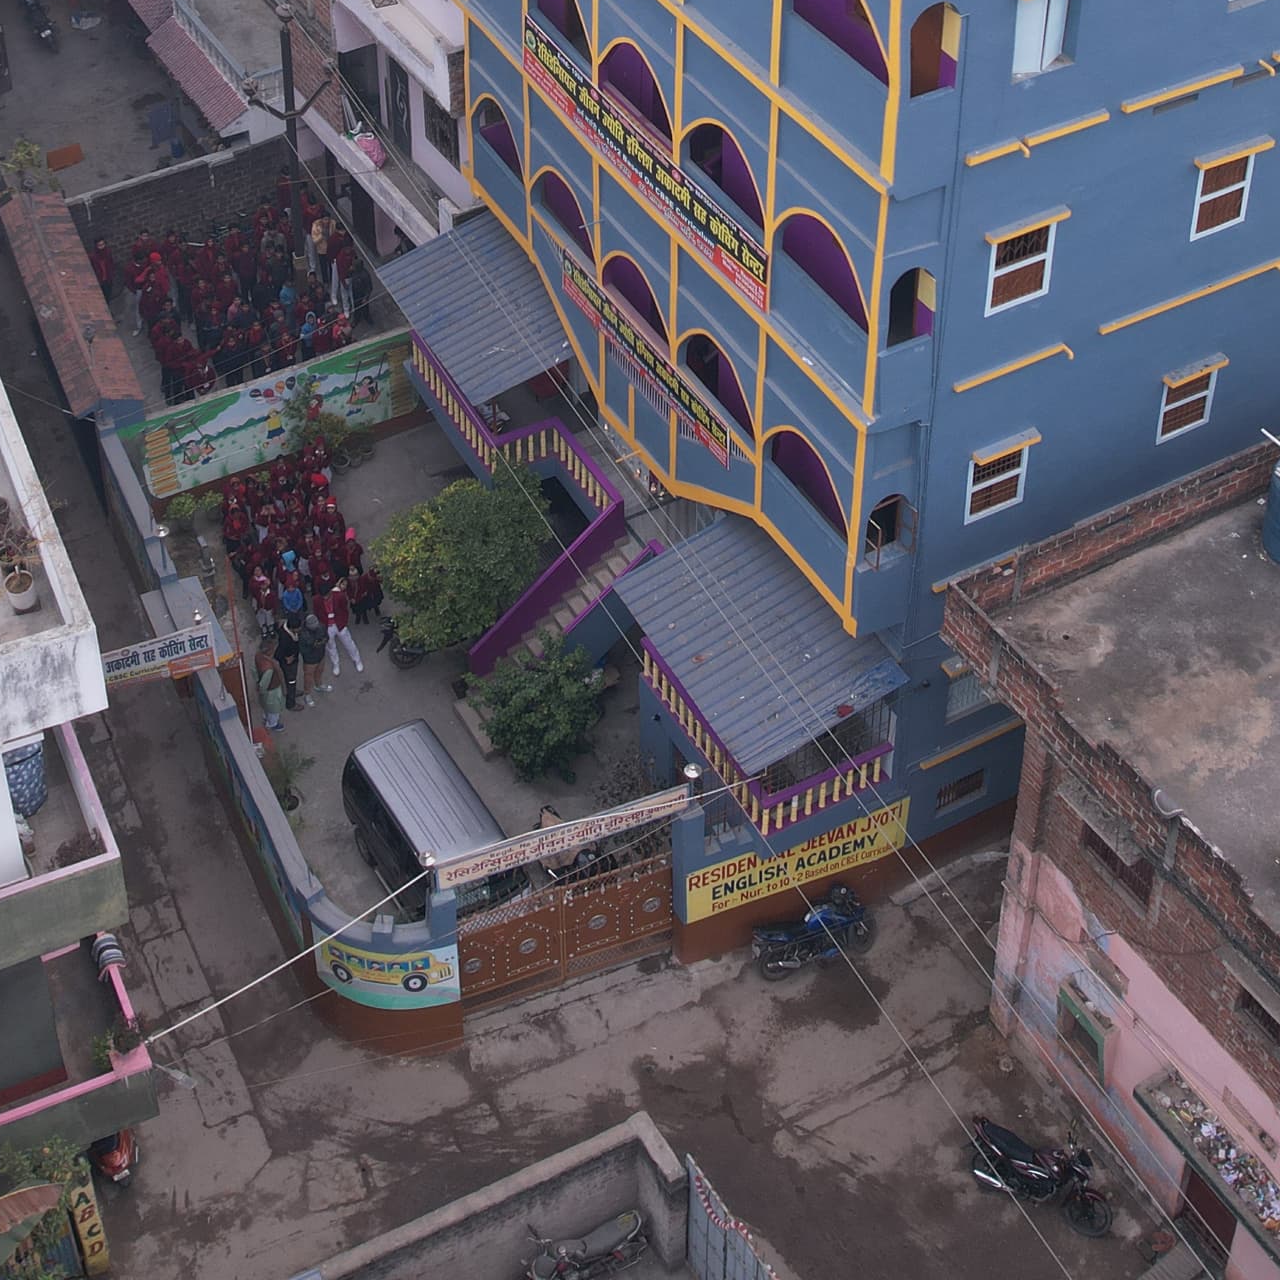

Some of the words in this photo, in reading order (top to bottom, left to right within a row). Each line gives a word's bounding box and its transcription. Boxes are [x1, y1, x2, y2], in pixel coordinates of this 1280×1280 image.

[105, 651, 140, 673] अकादमी
[142, 649, 156, 663] सह
[158, 638, 186, 658] कोचिंग
[801, 822, 857, 852] JEEVAN
[861, 803, 902, 832] JYOTI
[711, 862, 788, 900] ENGLISH
[795, 831, 879, 871] ACADEMY
[767, 883, 778, 892] to
[805, 864, 828, 879] Based
[829, 862, 840, 871] on
